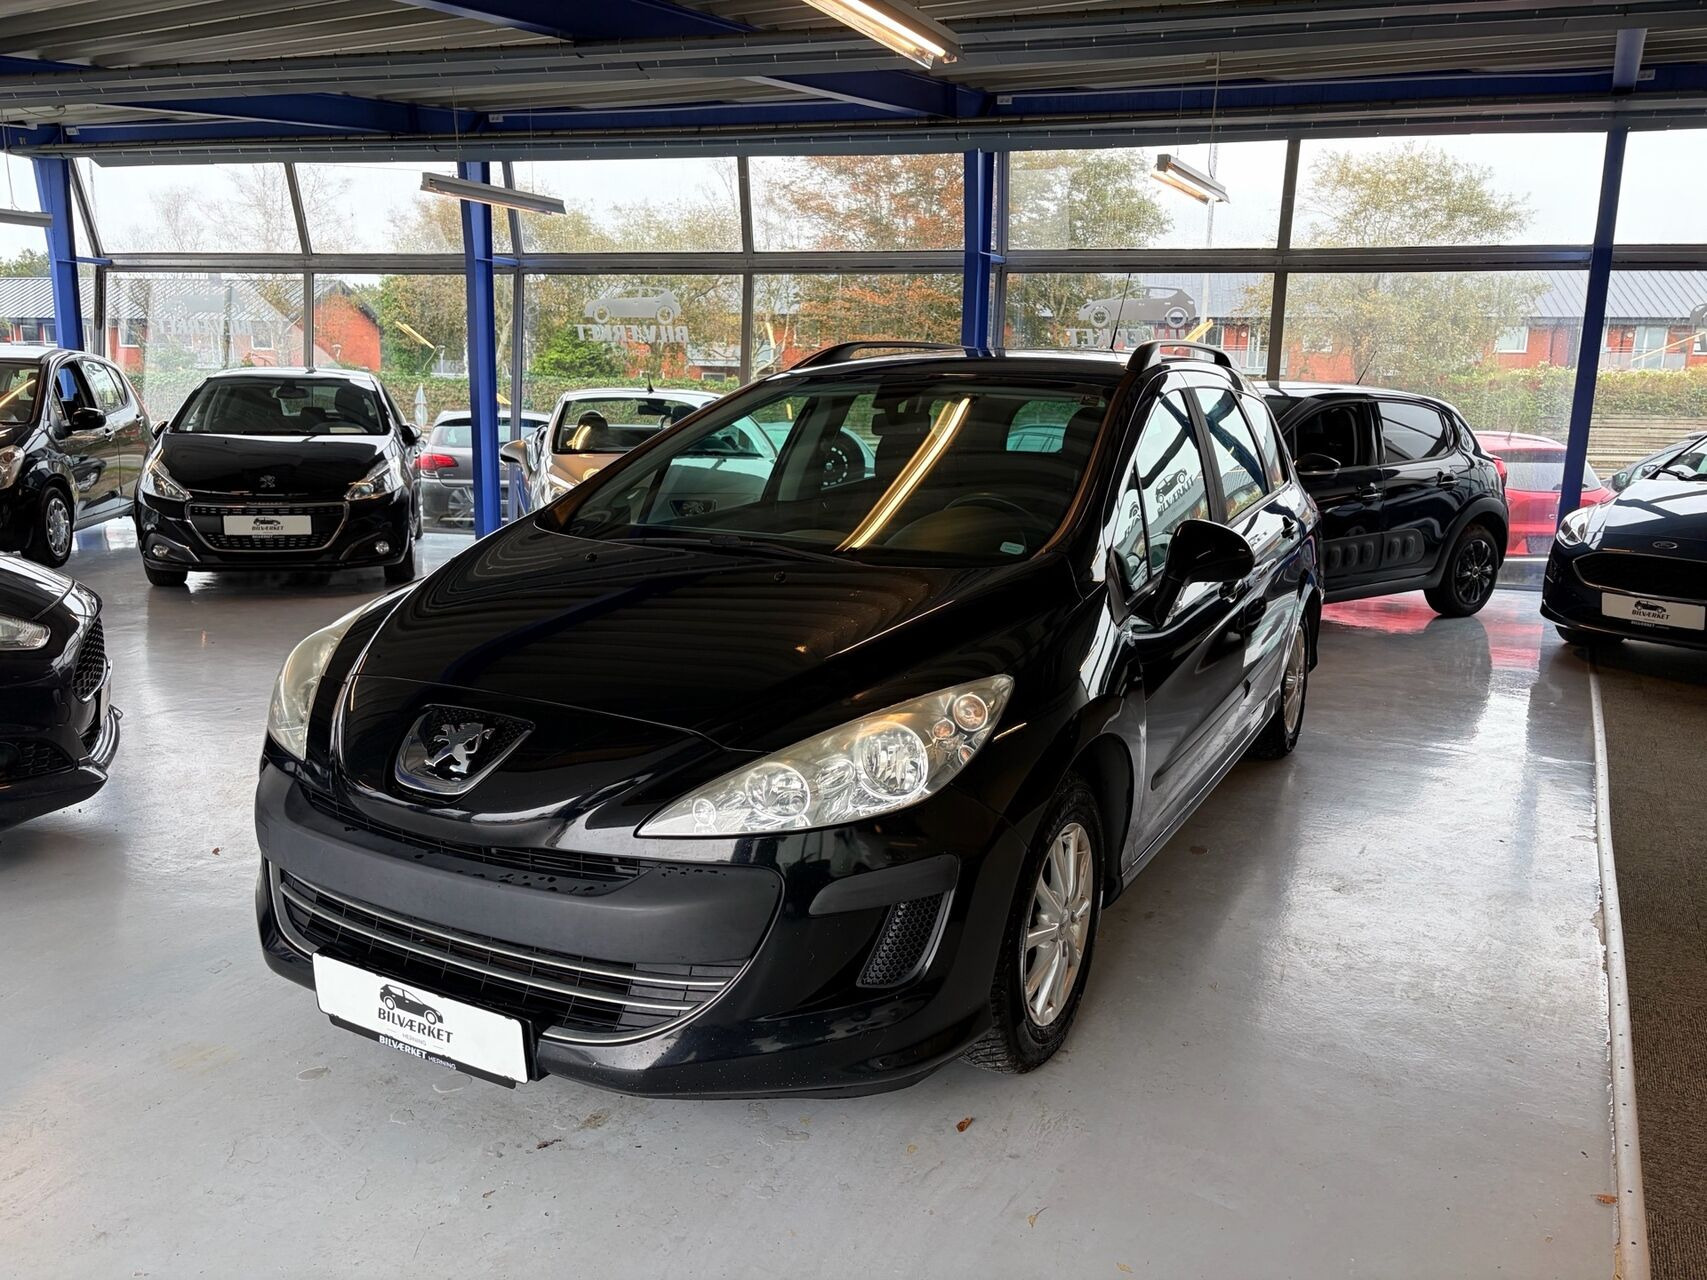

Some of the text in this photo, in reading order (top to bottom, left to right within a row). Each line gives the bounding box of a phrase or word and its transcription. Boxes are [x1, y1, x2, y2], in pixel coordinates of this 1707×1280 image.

[377, 1007, 454, 1044] BILVÆRKET
[379, 1034, 457, 1071] BILVÆRKET HERNING
